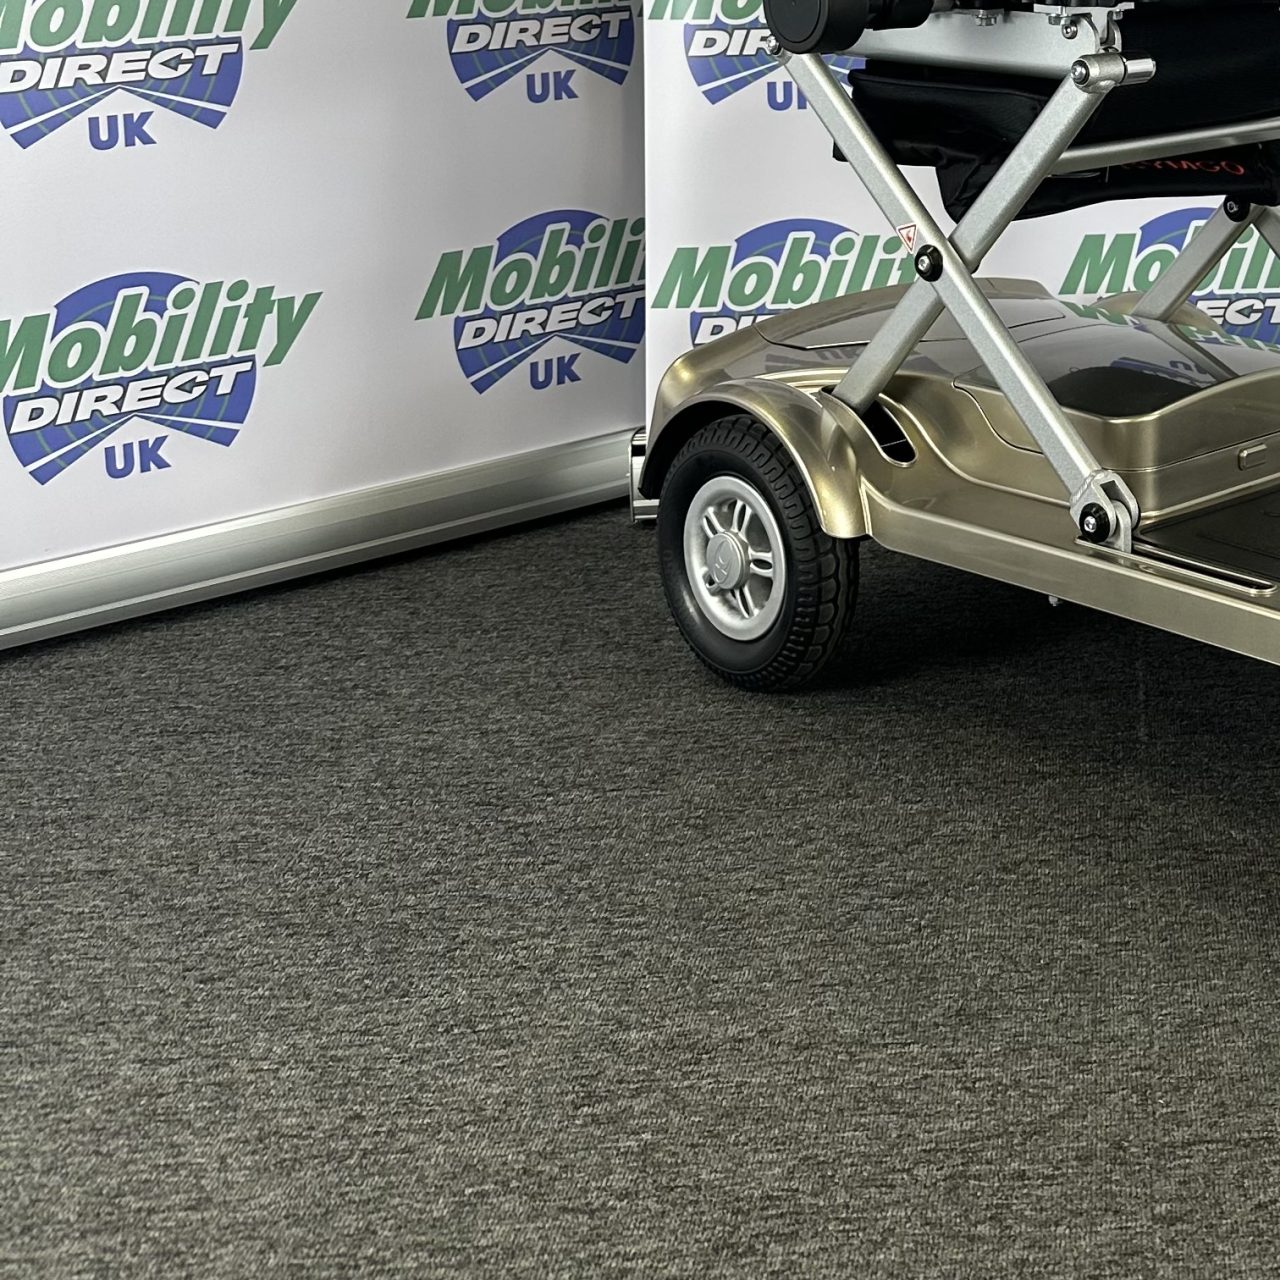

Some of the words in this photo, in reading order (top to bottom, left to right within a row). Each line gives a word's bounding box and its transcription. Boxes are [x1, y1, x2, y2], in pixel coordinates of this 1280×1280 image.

[451, 11, 630, 53] DIRECT
[0, 43, 239, 93] DIRECT
[526, 69, 579, 104] UK
[88, 111, 157, 151] UK
[415, 217, 646, 320] Mobili
[457, 291, 646, 350] DIRECT
[530, 352, 582, 390] UK
[9, 362, 253, 435] DIRECT
[104, 435, 171, 479] UK
